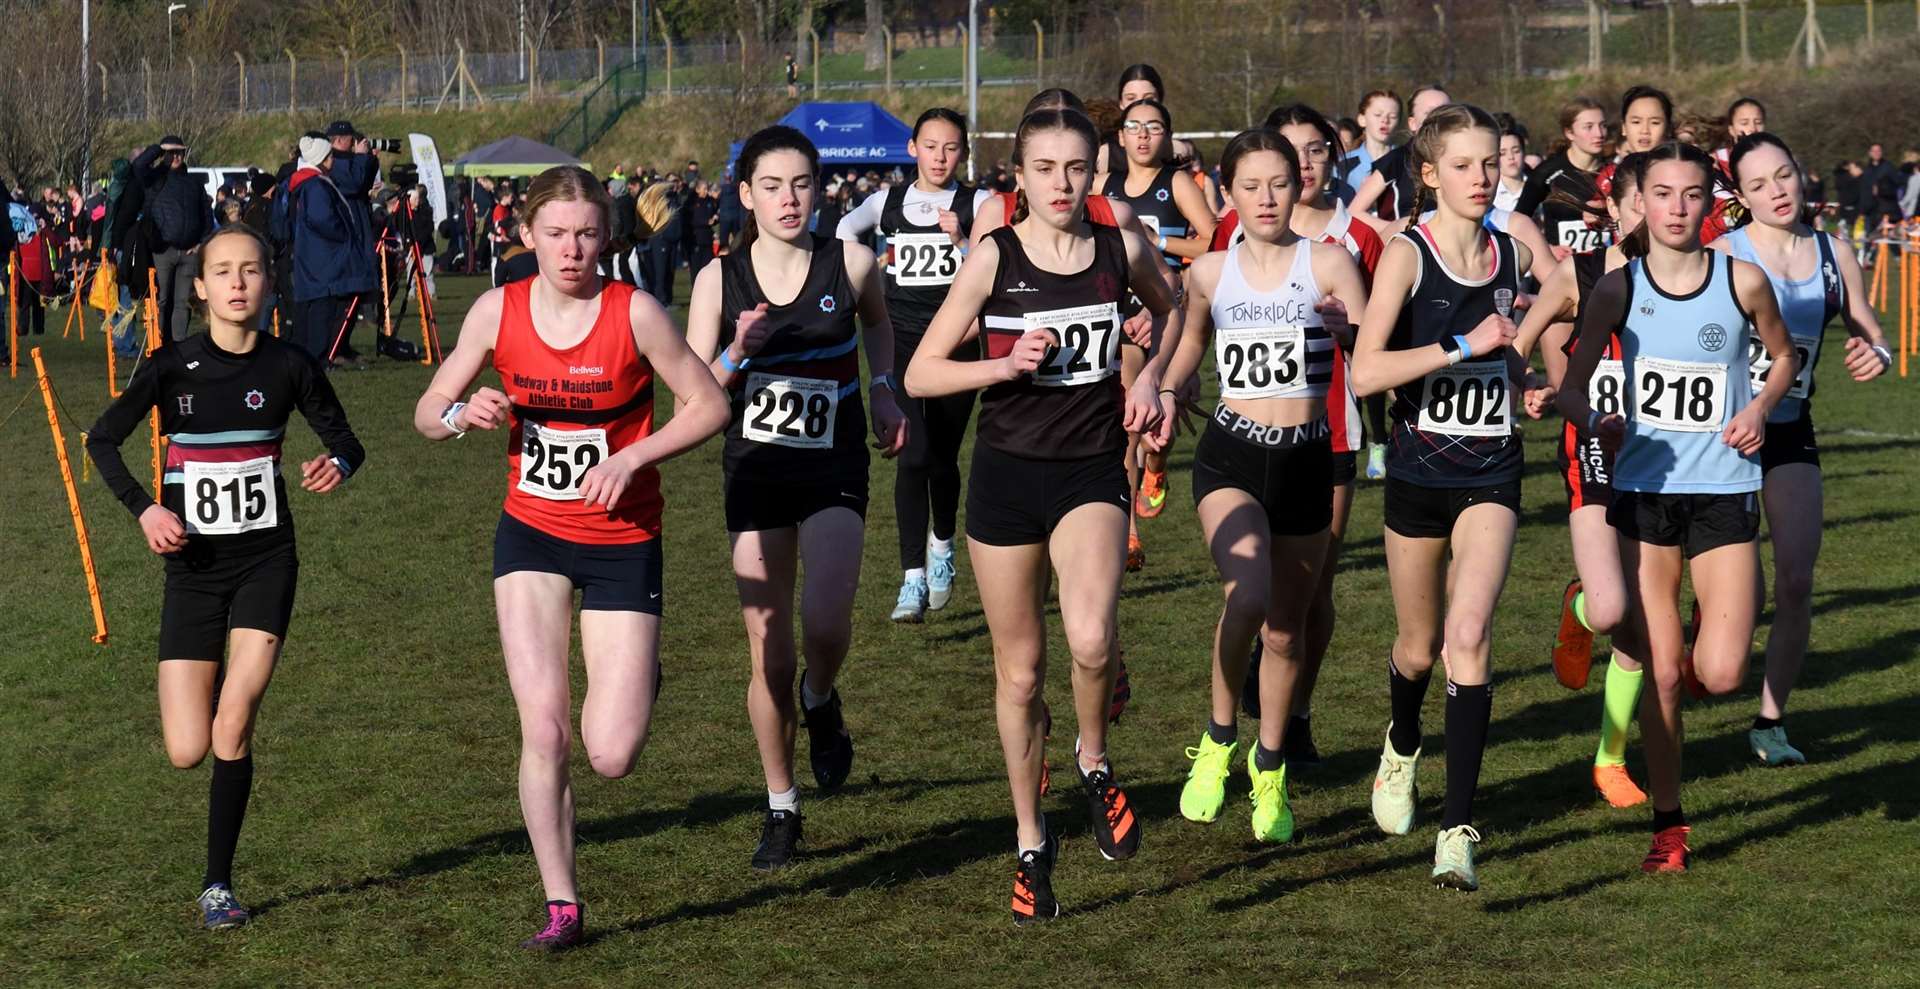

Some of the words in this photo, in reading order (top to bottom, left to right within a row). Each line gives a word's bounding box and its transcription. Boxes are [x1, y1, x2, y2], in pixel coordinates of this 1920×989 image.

[818, 147, 866, 158] BRIDGE
[869, 147, 887, 157] AC
[900, 245, 957, 277] 223
[1225, 299, 1306, 324] TONBRIDGE
[1038, 319, 1114, 375] 227
[1224, 341, 1298, 388] 283
[513, 373, 547, 392] Medway
[551, 378, 558, 391] &
[561, 379, 614, 393] Maidstone
[569, 366, 604, 376] Bellway
[528, 393, 566, 408] Athletic
[569, 396, 593, 409] Club
[750, 387, 830, 438] 228
[1428, 376, 1505, 426] 802
[1641, 371, 1714, 422] 218
[1231, 415, 1283, 445] PRO
[525, 437, 600, 490] 252
[196, 474, 267, 524] 815
